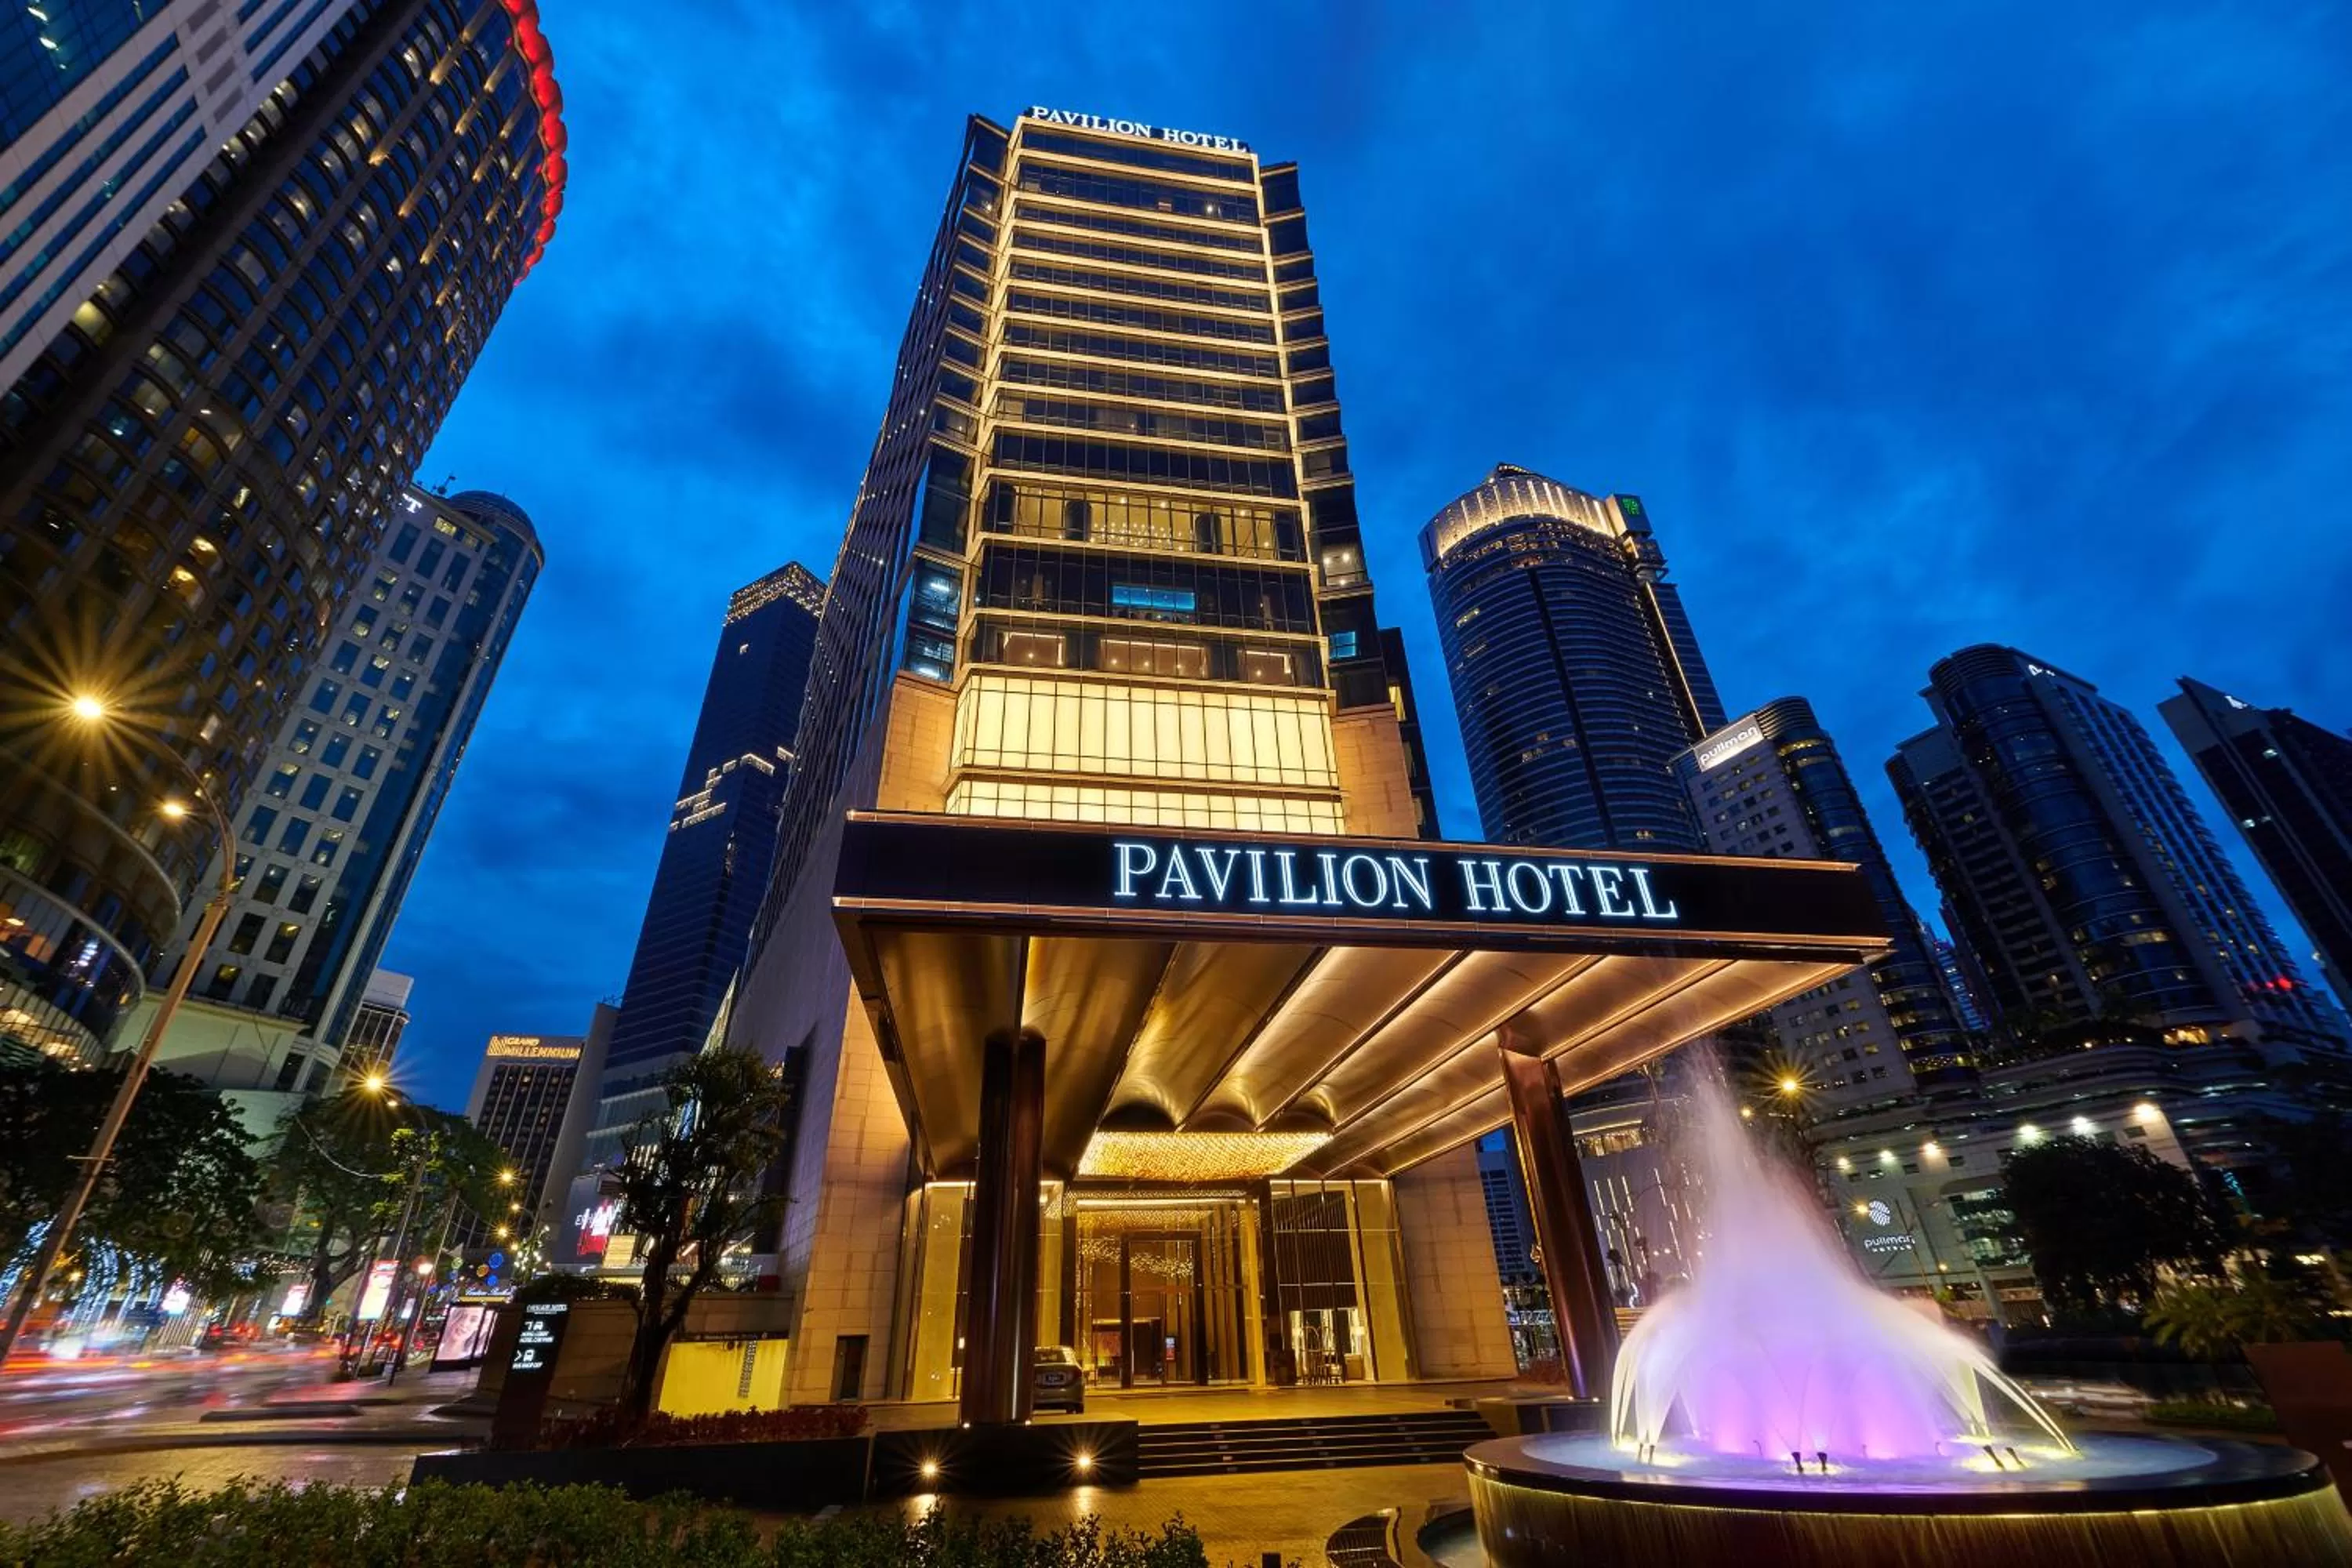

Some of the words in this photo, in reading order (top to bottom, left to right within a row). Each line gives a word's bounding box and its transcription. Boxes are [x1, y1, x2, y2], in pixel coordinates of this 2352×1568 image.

[1032, 105, 1152, 139] PAVILION
[1162, 127, 1248, 153] HOTEL
[1699, 726, 1759, 768] pullman
[1113, 842, 1434, 910] PAVILION
[1458, 859, 1679, 920] HOTEL
[504, 1045, 581, 1060] MILLENNIUM
[507, 1036, 540, 1047] GRAND
[1864, 1235, 1915, 1249] pullman
